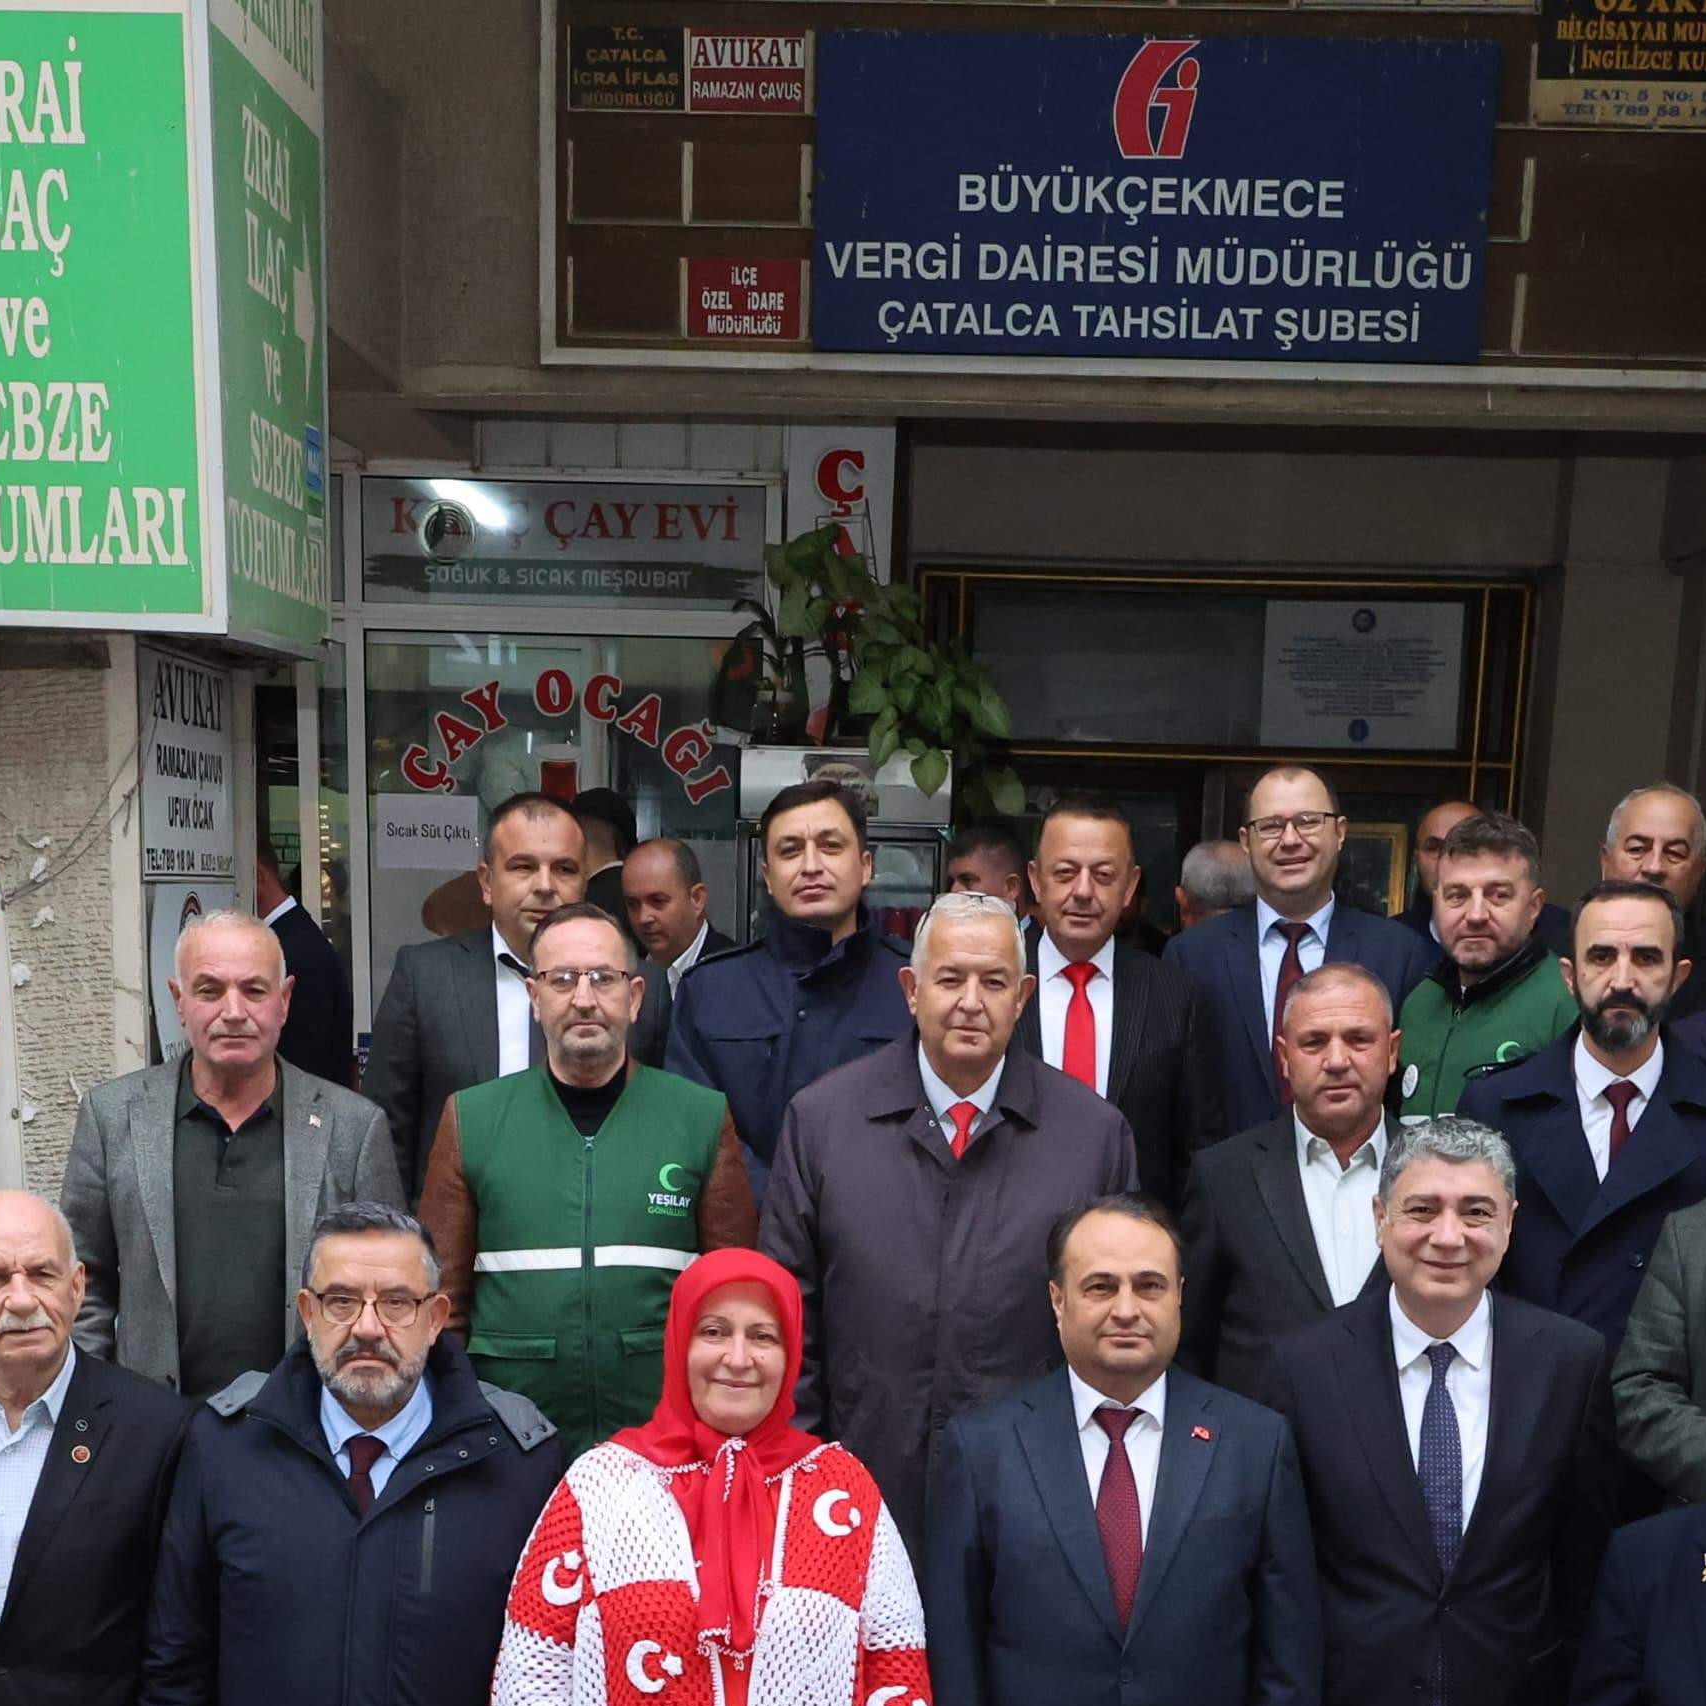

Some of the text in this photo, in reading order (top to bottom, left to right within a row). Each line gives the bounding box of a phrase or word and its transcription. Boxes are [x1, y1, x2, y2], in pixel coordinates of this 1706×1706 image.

[574, 67, 679, 86] İCRA İFLAS
[586, 48, 667, 66] ÇATALCA
[694, 37, 802, 67] AVUKAT
[693, 80, 802, 102] RAMAZAN ÇAVUŞ
[242, 91, 292, 222] ZİRAİ
[957, 164, 1345, 225] BÜYÜKÇEKMECE
[244, 186, 287, 335] İLAÇ
[824, 232, 1473, 291] VERGİ DAİRESİ MÜDÜRLÜĞÜ
[701, 286, 733, 310] ÖZEL
[877, 298, 1421, 351] ÇATALCA TAHSİLAT ŞUBESİ
[262, 341, 282, 405] ve
[250, 410, 304, 511] SEBZE
[544, 499, 643, 551] ÇAY
[651, 495, 740, 542] EVİ
[423, 562, 692, 593] SOĞUK & SICAK MEŞRUBAT
[152, 657, 223, 732] AVUKAT
[400, 667, 733, 806] ÇAY OCAĞI
[156, 743, 223, 792] RAMAZAN ÇAVUŞ
[167, 796, 191, 829] UFUK
[386, 821, 471, 843] Sıcak Süt Çıktı
